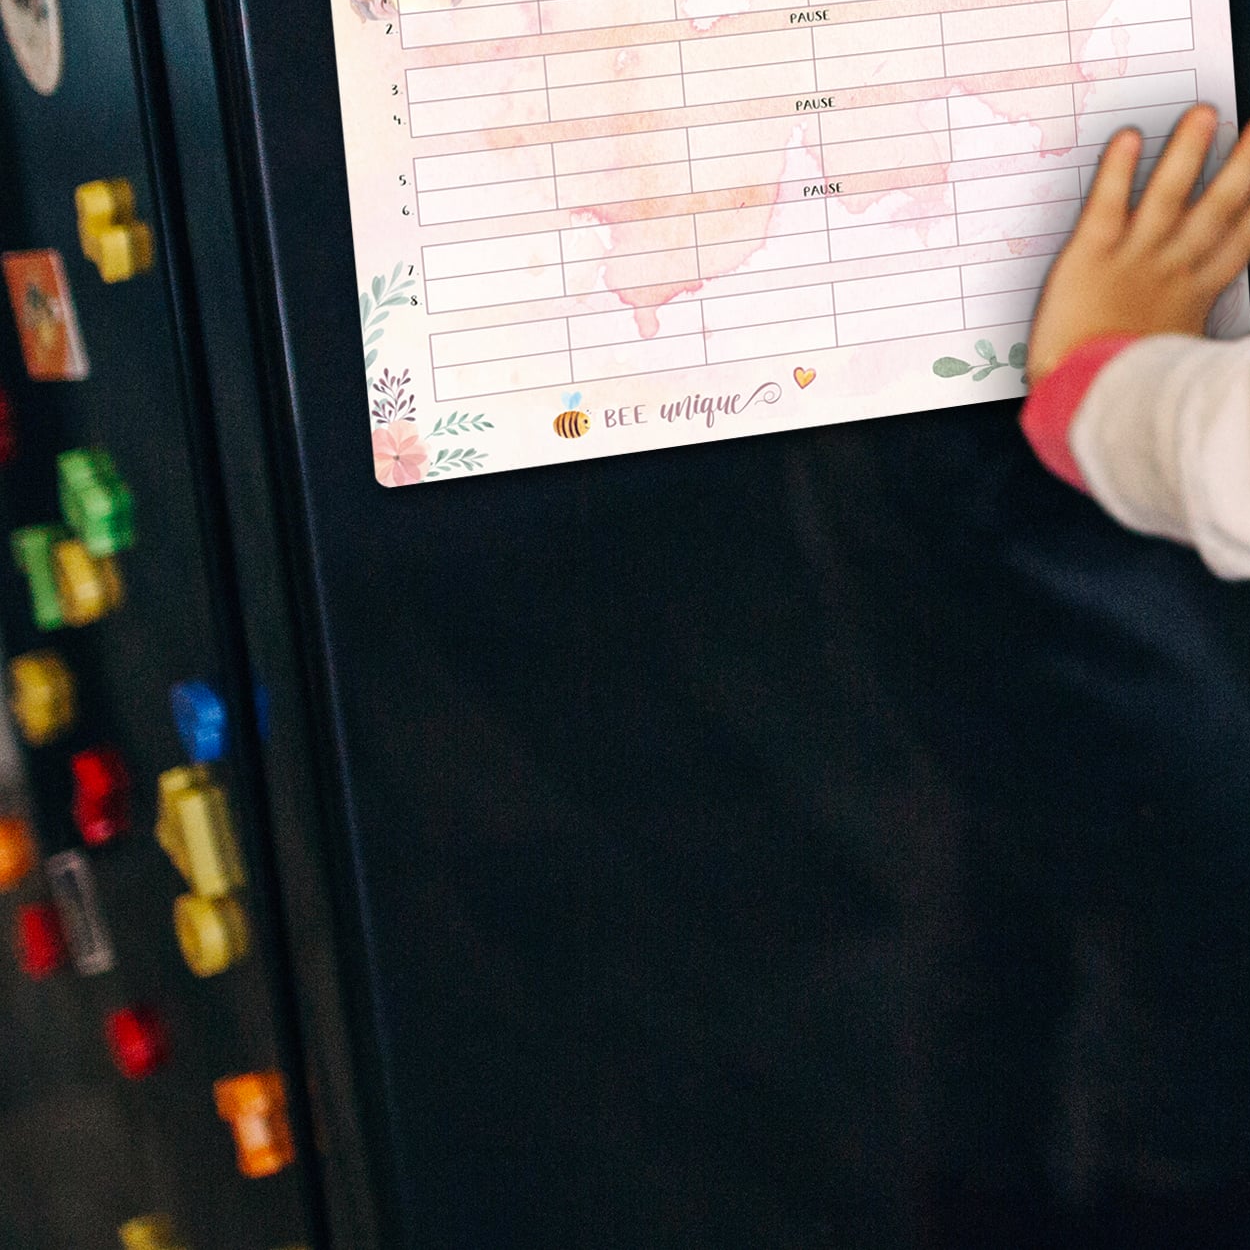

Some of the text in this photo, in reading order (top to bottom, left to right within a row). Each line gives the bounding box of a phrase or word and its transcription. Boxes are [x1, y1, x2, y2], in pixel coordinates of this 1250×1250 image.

[789, 9, 830, 24] PAUSE
[795, 96, 836, 111] PAUSE
[803, 182, 844, 197] PAUSE
[604, 381, 783, 429] BEE unique
